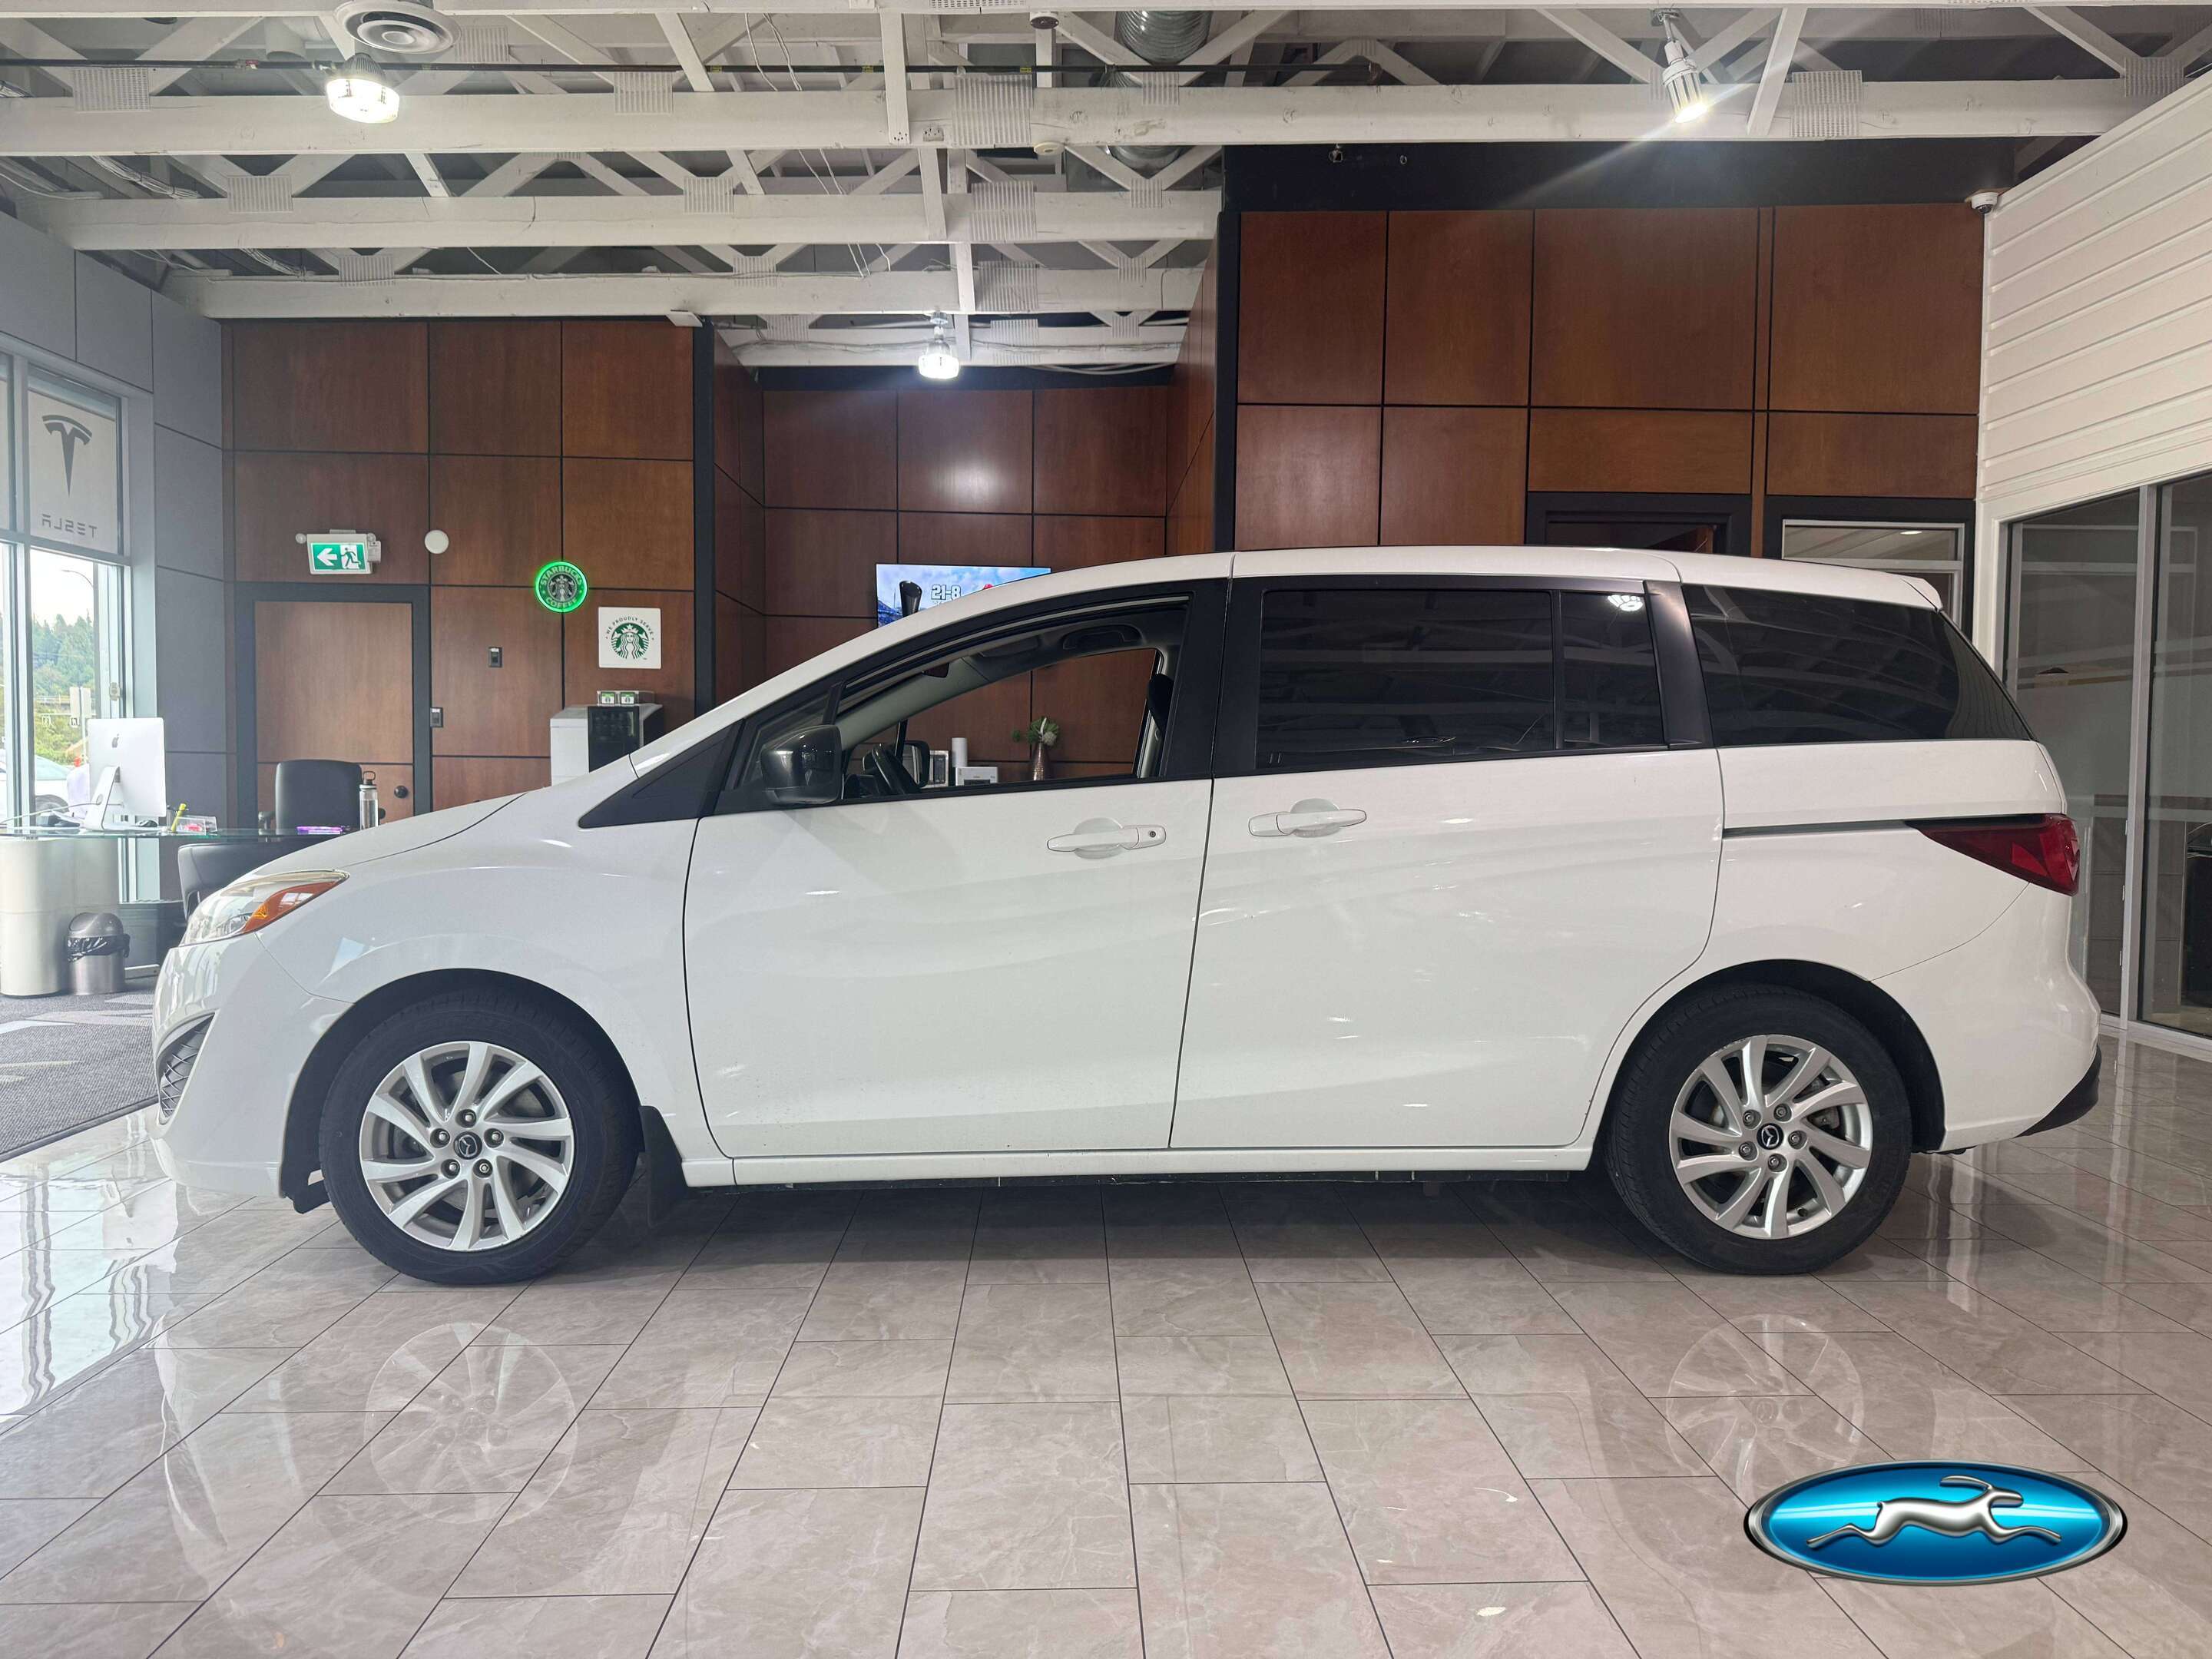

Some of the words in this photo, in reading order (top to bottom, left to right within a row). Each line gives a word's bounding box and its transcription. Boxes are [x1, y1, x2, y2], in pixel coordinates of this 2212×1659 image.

[540, 565, 583, 585] STARBUCKS
[612, 616, 637, 626] PROUDLY
[640, 619, 654, 634] SERVE
